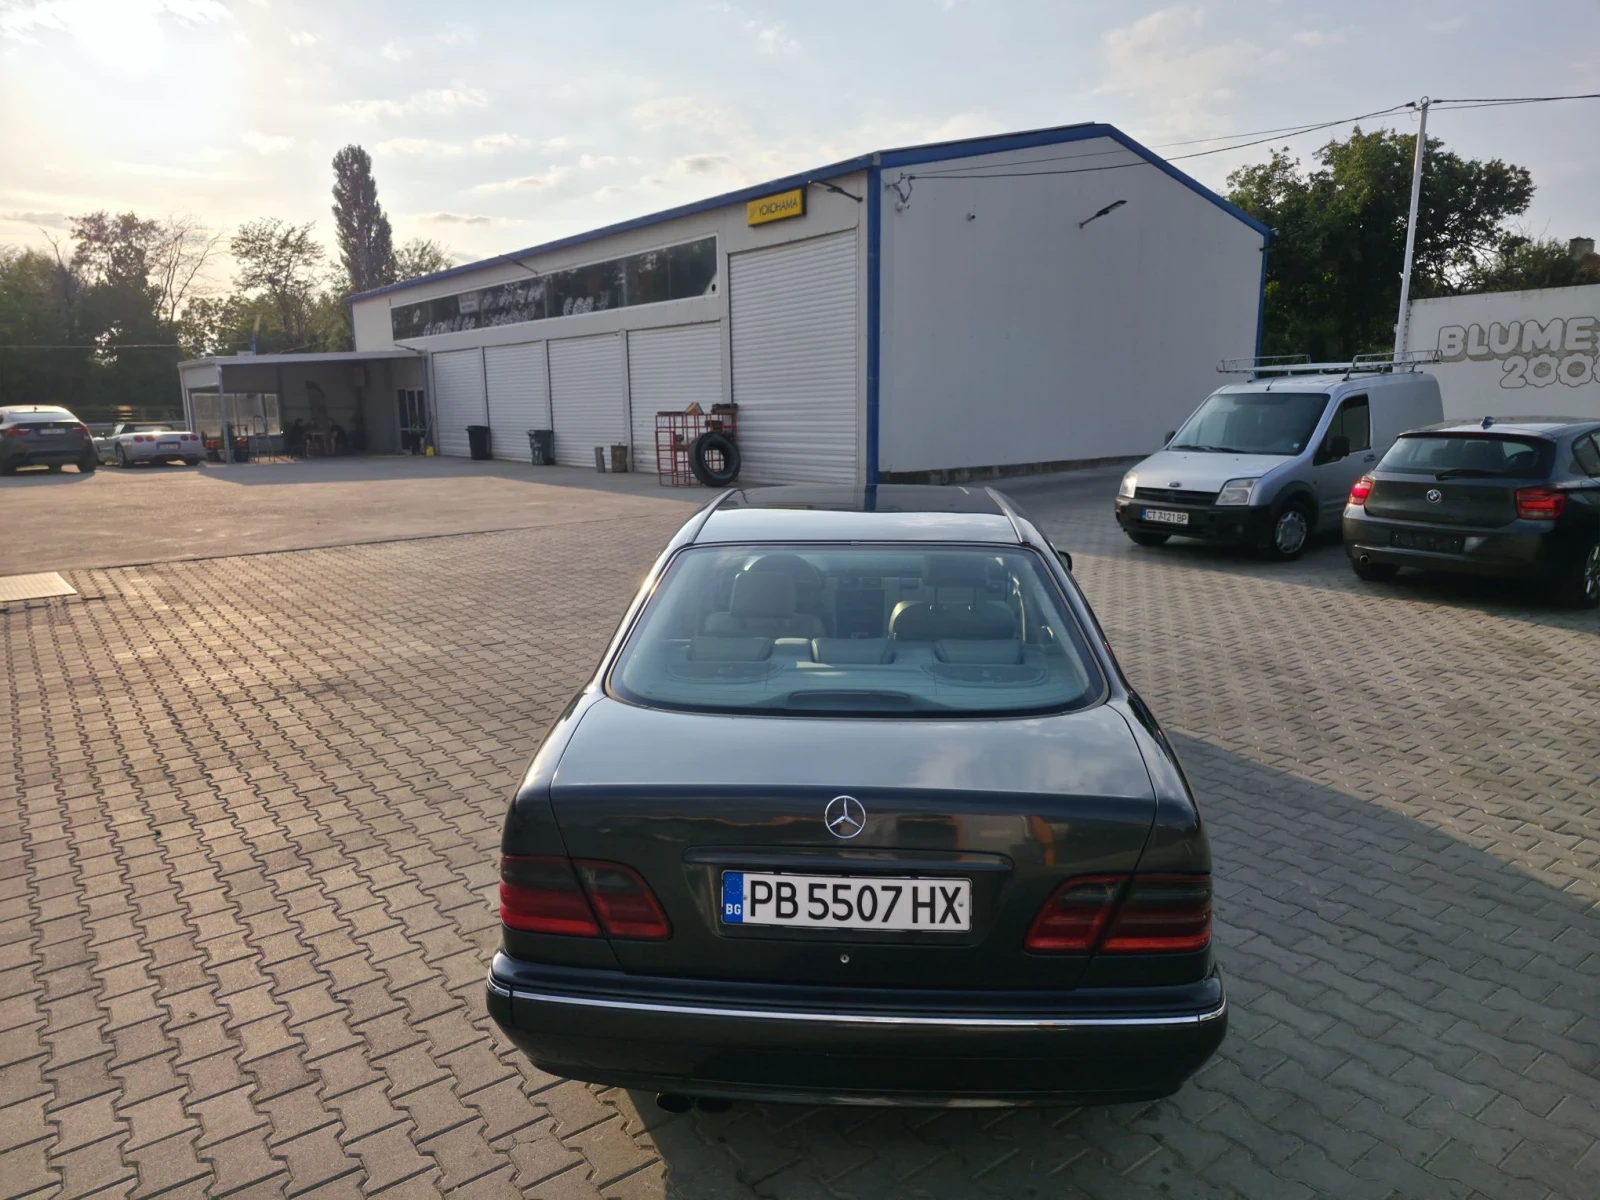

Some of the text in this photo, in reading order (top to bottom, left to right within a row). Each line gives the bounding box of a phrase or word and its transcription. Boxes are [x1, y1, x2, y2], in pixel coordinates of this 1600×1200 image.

[759, 197, 798, 216] YOKOHAMA
[1437, 316, 1600, 362] BLUME
[1500, 353, 1600, 389] 200
[1147, 511, 1157, 519] CT
[1177, 513, 1187, 522] BP
[725, 903, 741, 915] BG
[750, 880, 962, 924] PB 5507 HX
